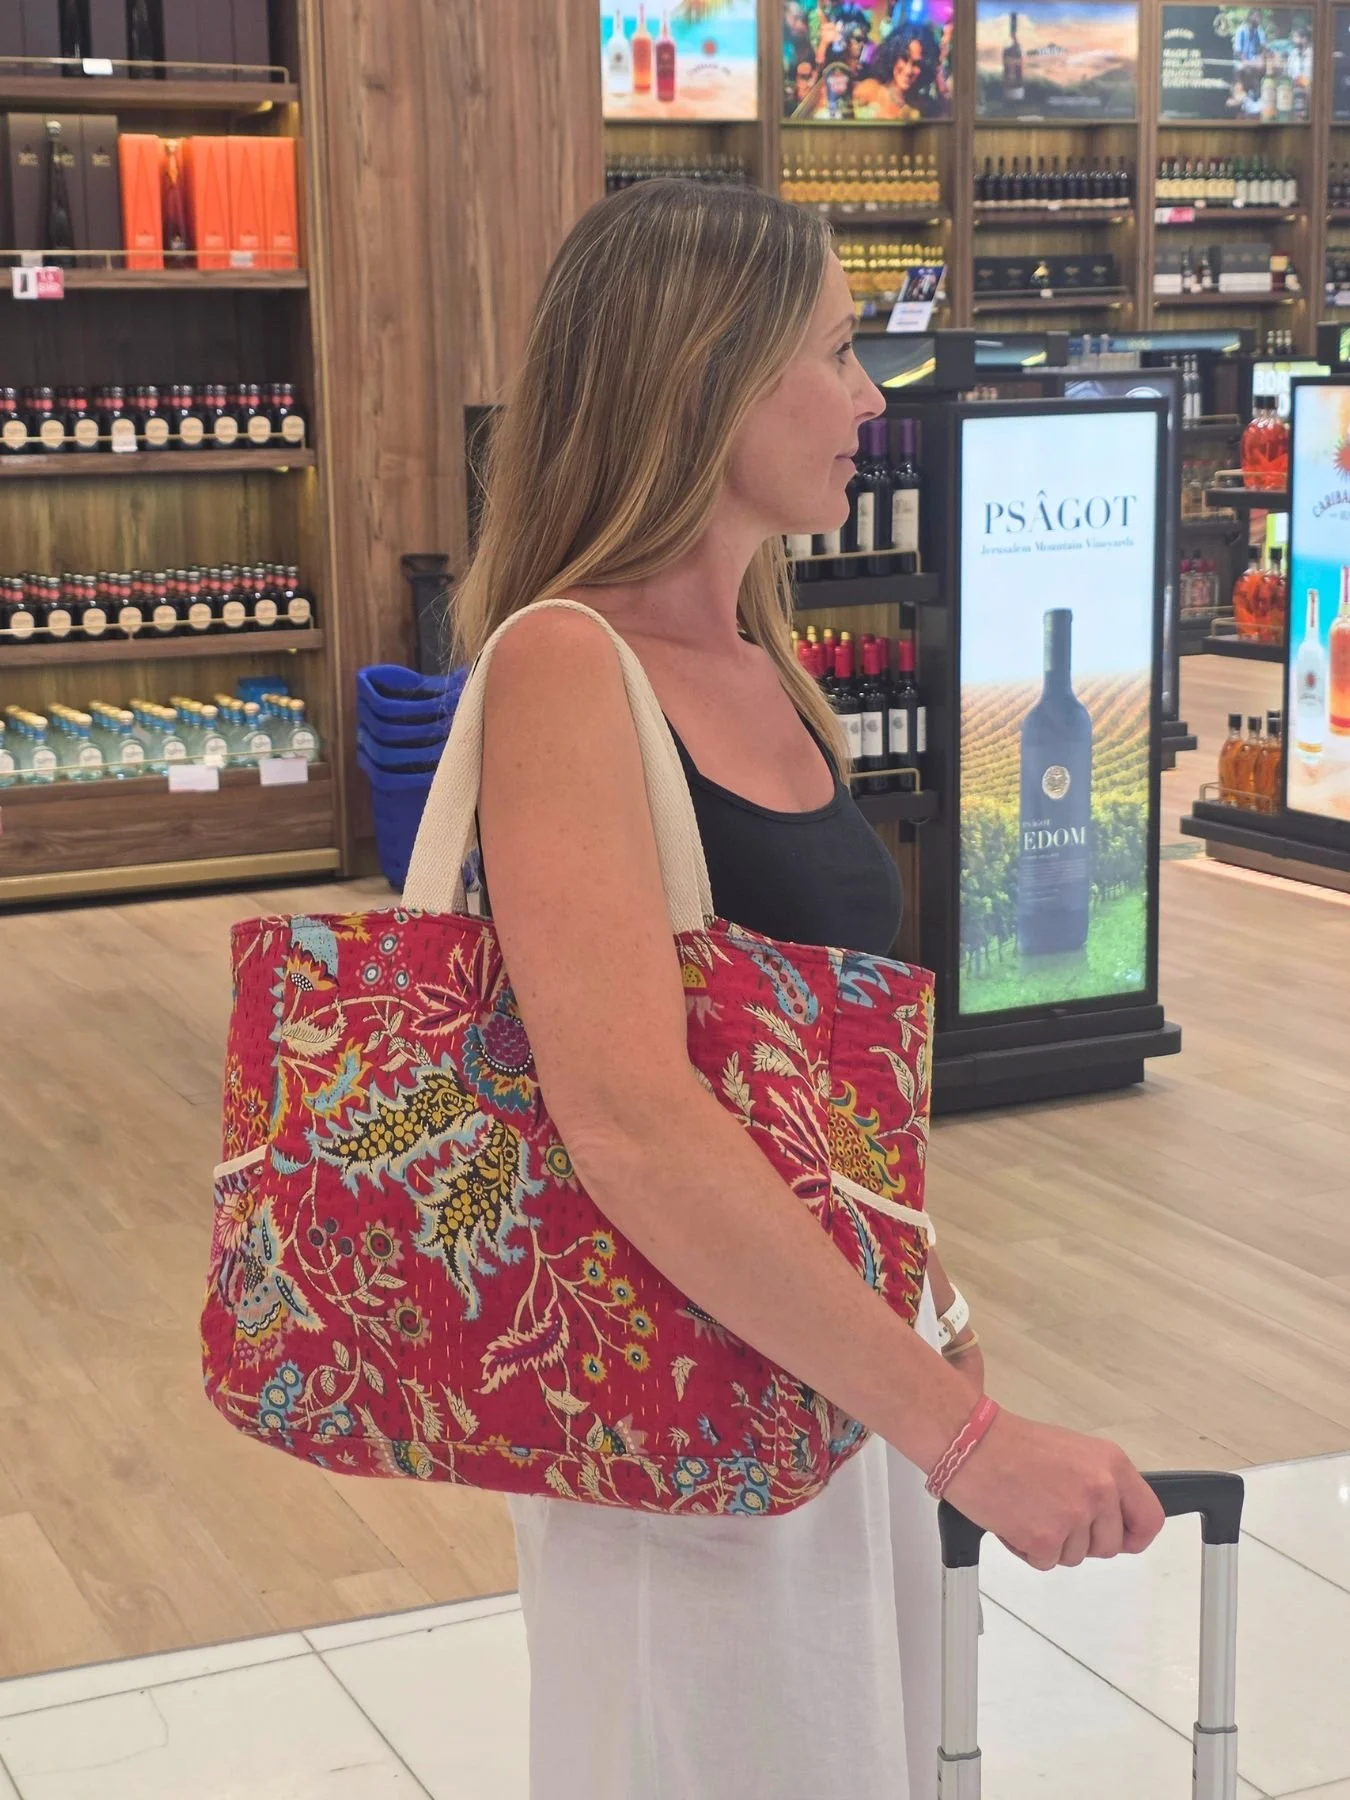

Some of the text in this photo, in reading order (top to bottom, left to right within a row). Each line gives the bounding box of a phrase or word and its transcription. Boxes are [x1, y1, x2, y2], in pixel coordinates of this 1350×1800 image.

[984, 489, 1137, 534] PSÂGOT
[981, 536, 1135, 555] Jerusalem Mountain Vineyards
[1024, 826, 1086, 850] EDOM
